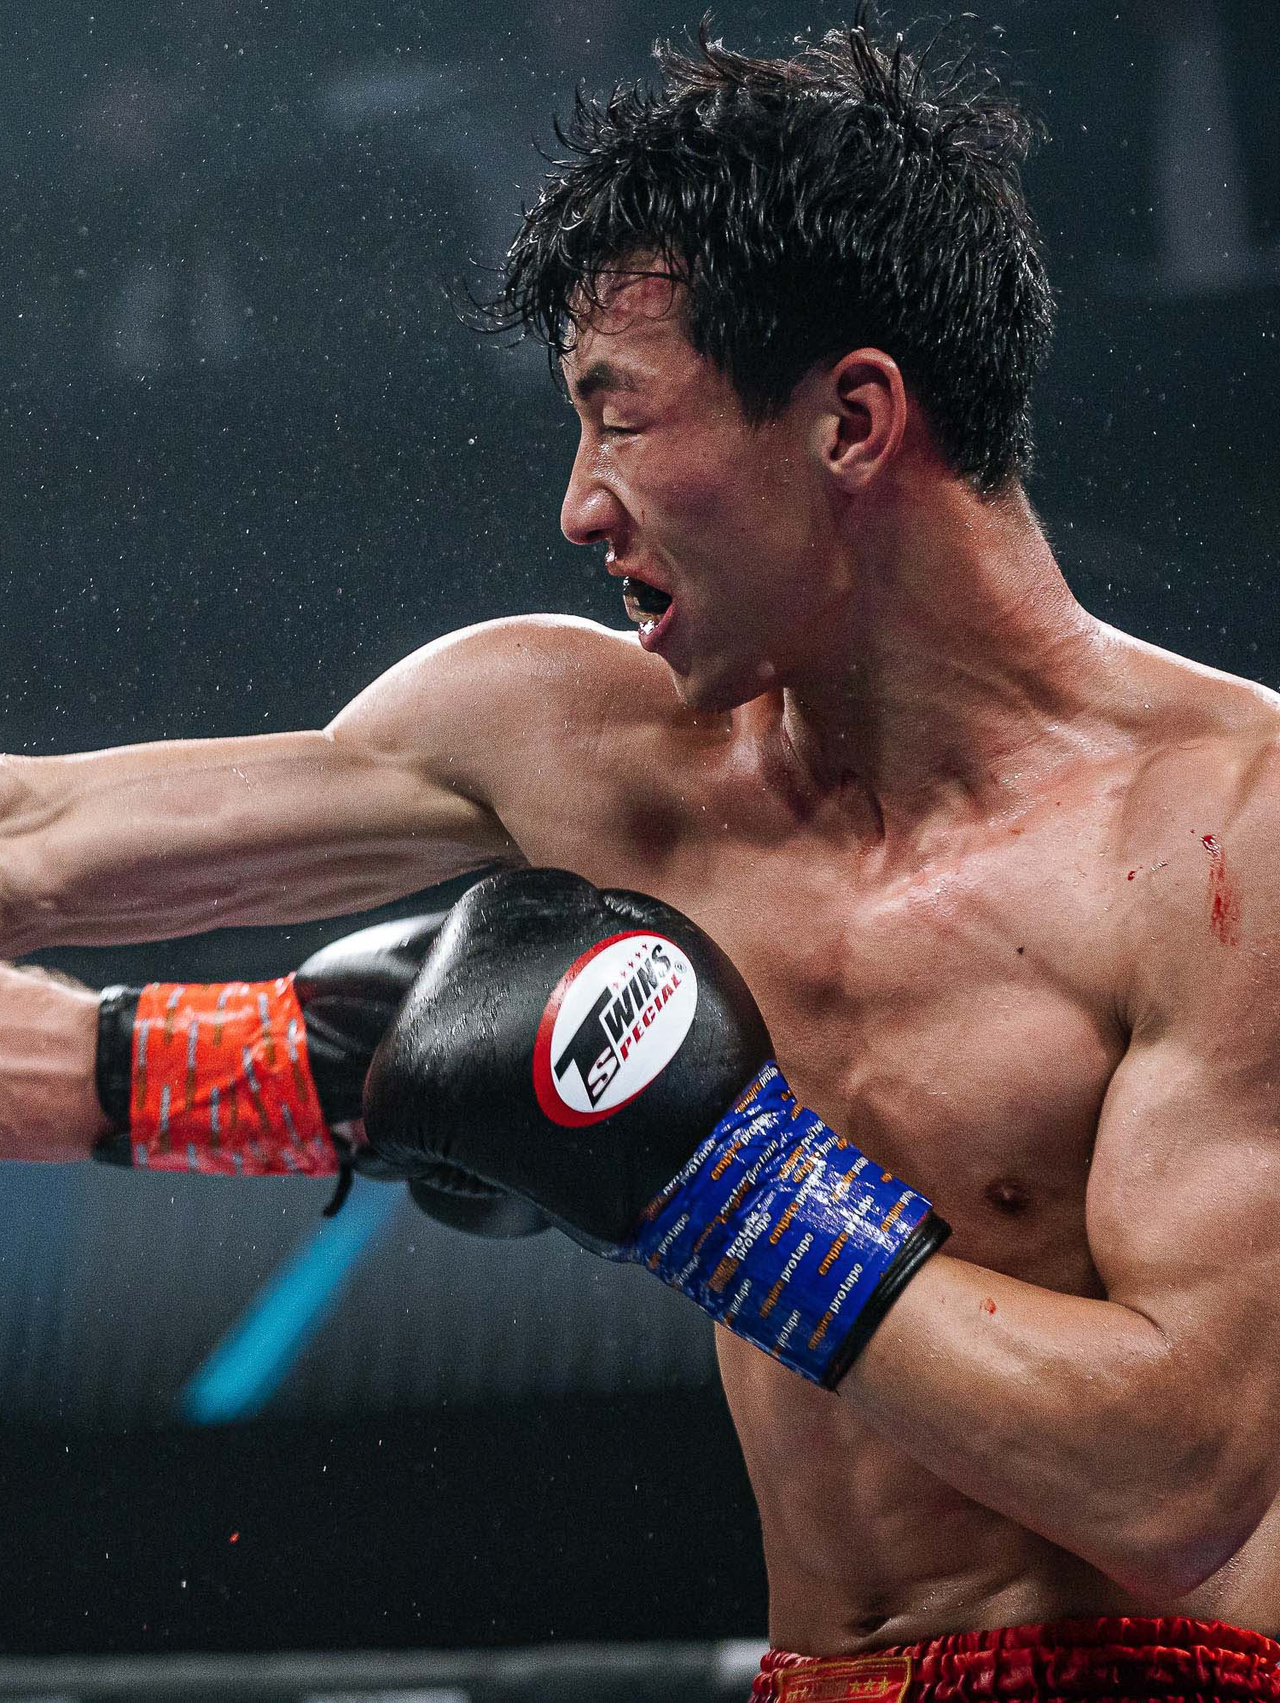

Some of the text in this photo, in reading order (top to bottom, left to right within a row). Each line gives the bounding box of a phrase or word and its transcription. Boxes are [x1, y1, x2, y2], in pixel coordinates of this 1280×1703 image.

[554, 944, 671, 1109] TWINS
[587, 973, 682, 1098] SPECIAL
[735, 1211, 772, 1260] protape
[780, 1232, 815, 1281] protape
[817, 1232, 848, 1275] empire
[829, 1263, 864, 1313] protape
